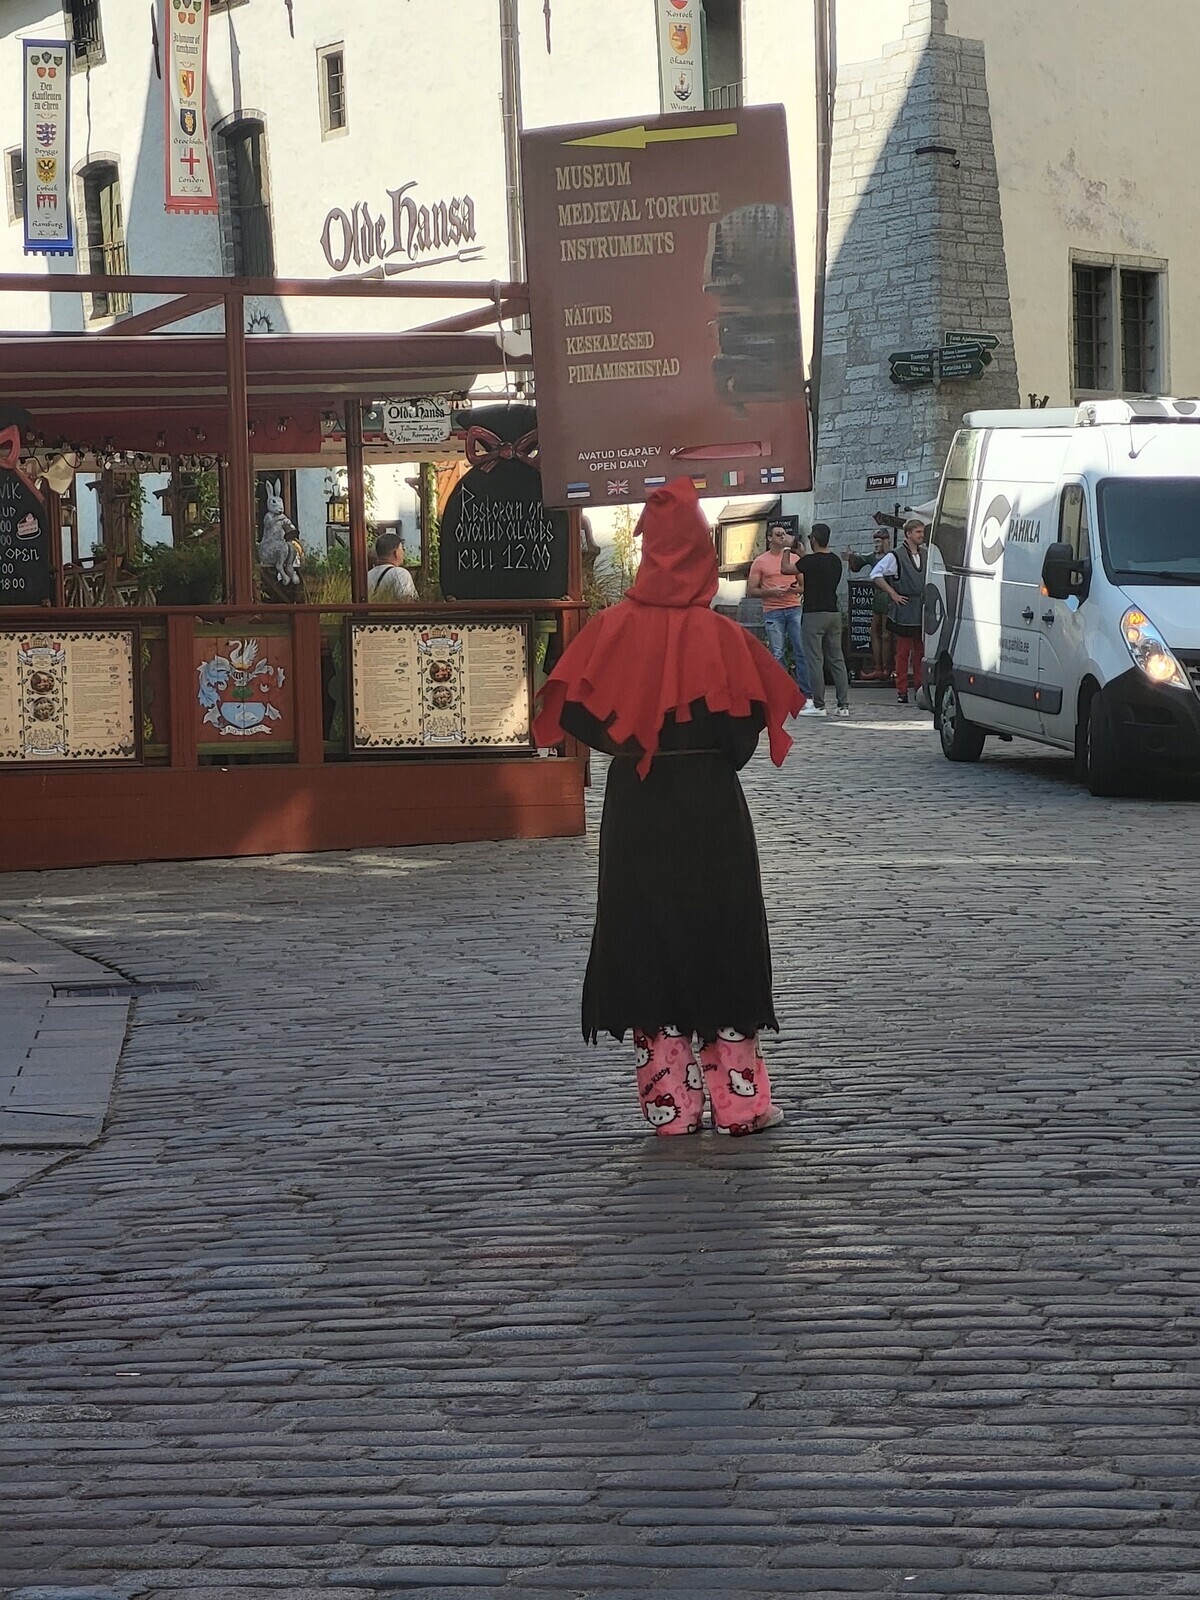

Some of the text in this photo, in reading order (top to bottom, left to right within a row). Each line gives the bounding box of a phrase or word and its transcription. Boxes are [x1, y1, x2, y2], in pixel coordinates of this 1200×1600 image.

[40, 82, 53, 91] Den
[41, 101, 59, 111] Ehren
[178, 175, 205, 184] London
[555, 161, 632, 191] MUSEUM
[557, 192, 721, 227] MEDIEVAL TORTURE
[320, 200, 387, 272] Olde
[560, 231, 675, 262] INSTRUMENTS
[566, 331, 655, 355] KESKAEGSED
[568, 357, 680, 384] PIINAMISRIISTAD
[577, 450, 615, 461] AVATUD
[589, 459, 649, 472] OPEN DAILY
[869, 478, 883, 486] Vana
[528, 501, 544, 521] on
[502, 543, 551, 572] 12.00
[851, 596, 875, 607] TODAY
